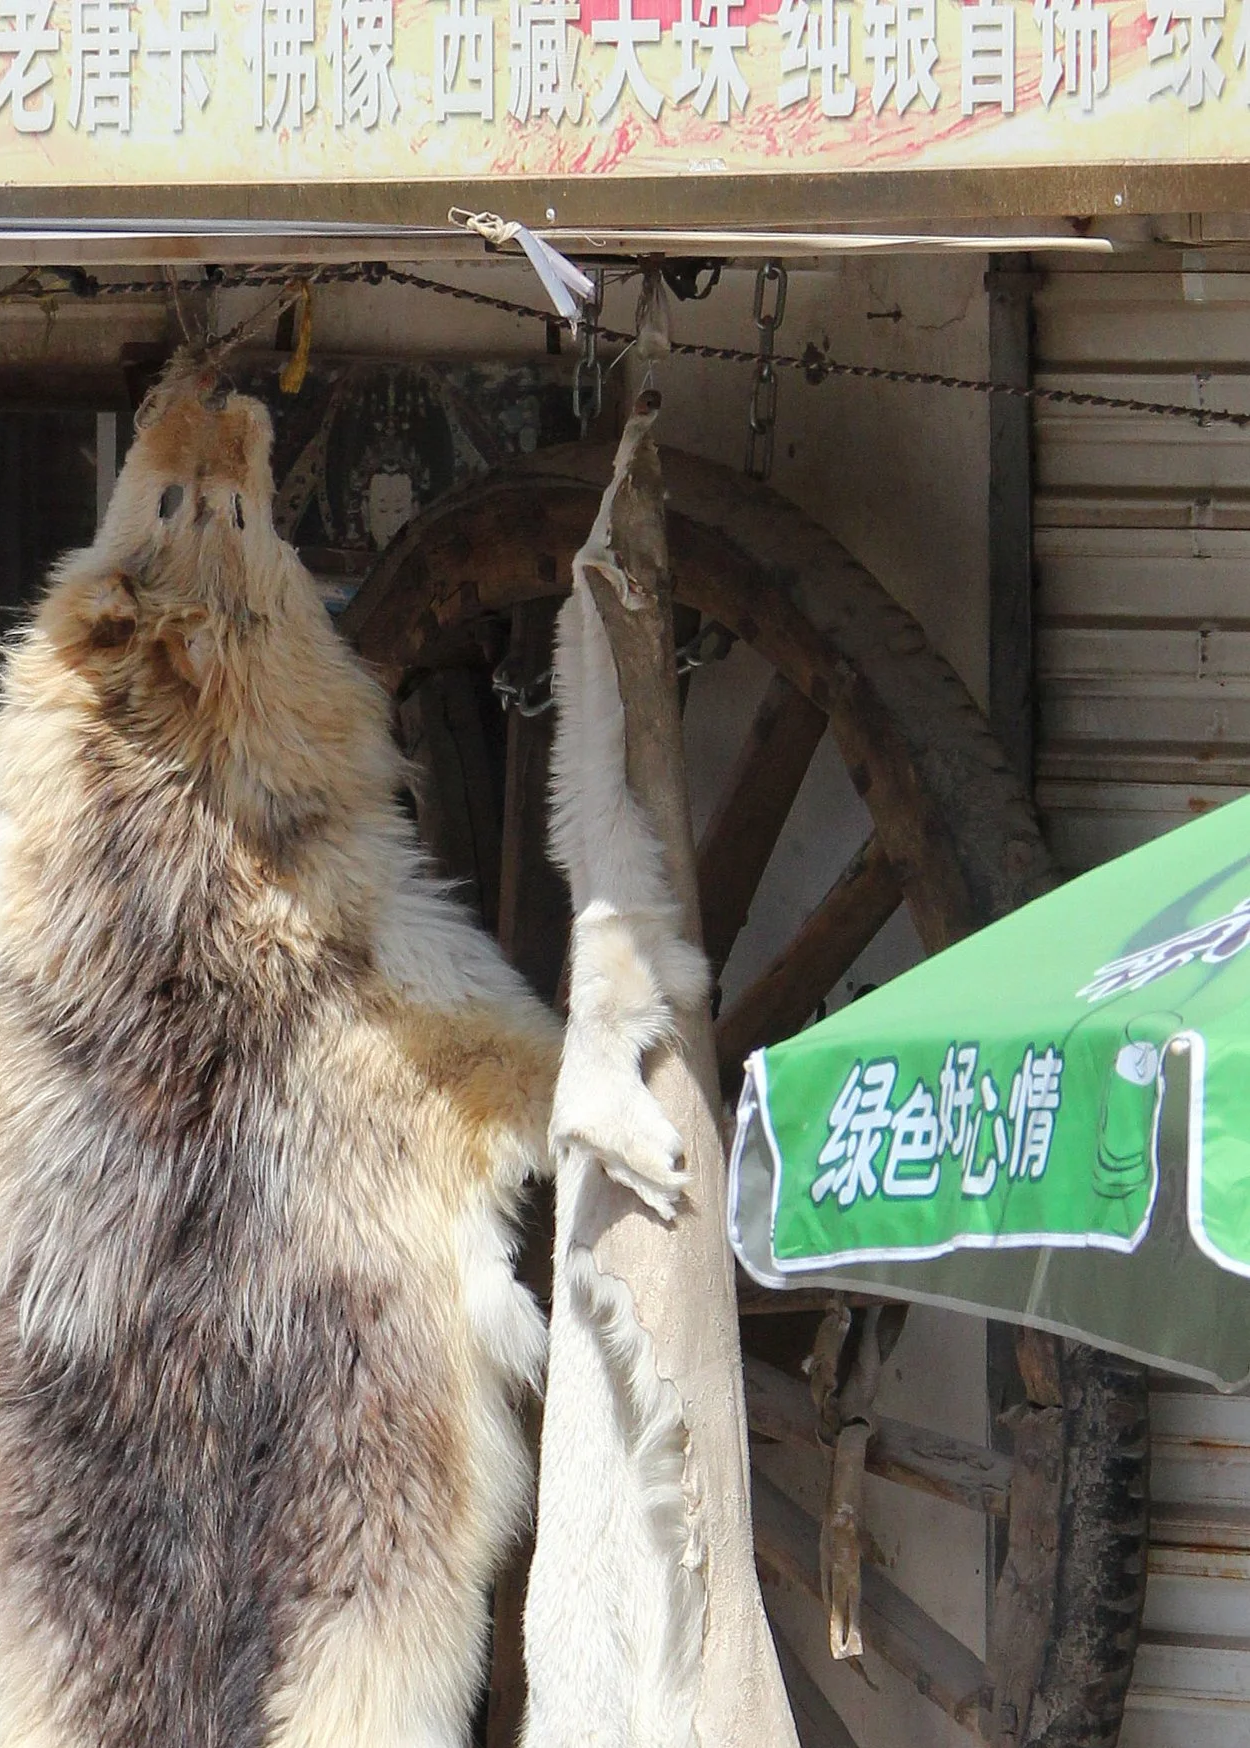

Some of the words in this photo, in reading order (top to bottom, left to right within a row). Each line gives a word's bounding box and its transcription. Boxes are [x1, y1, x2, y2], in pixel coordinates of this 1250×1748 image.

[811, 1041, 1063, 1212] 绿色好心情
